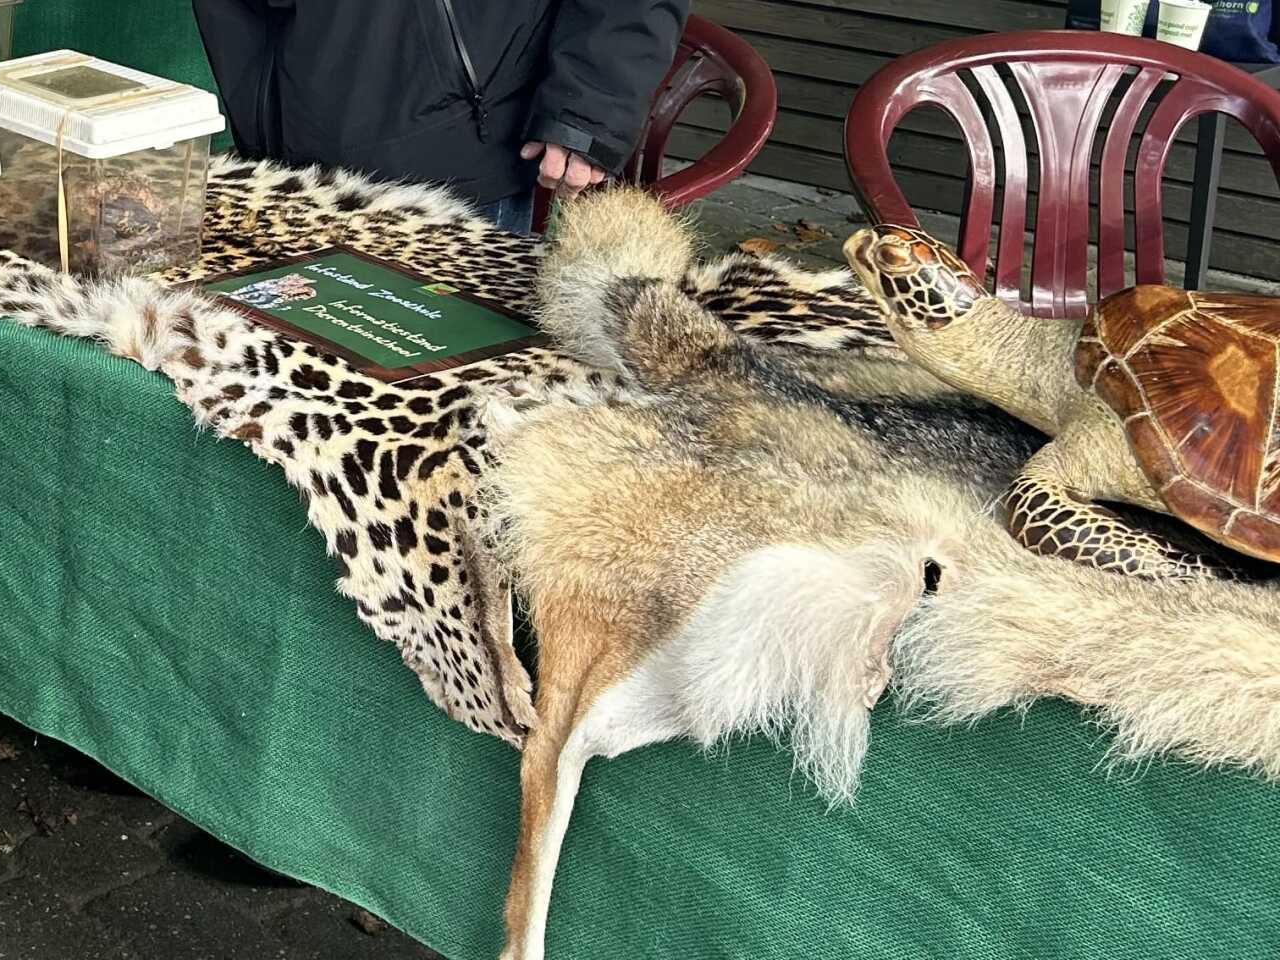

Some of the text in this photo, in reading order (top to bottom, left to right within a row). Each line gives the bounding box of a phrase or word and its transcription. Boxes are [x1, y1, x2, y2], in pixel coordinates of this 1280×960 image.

[303, 263, 443, 320] Infostand Zooschule
[302, 304, 422, 358] Dierentuinschool
[327, 299, 448, 352] Informatiestand
